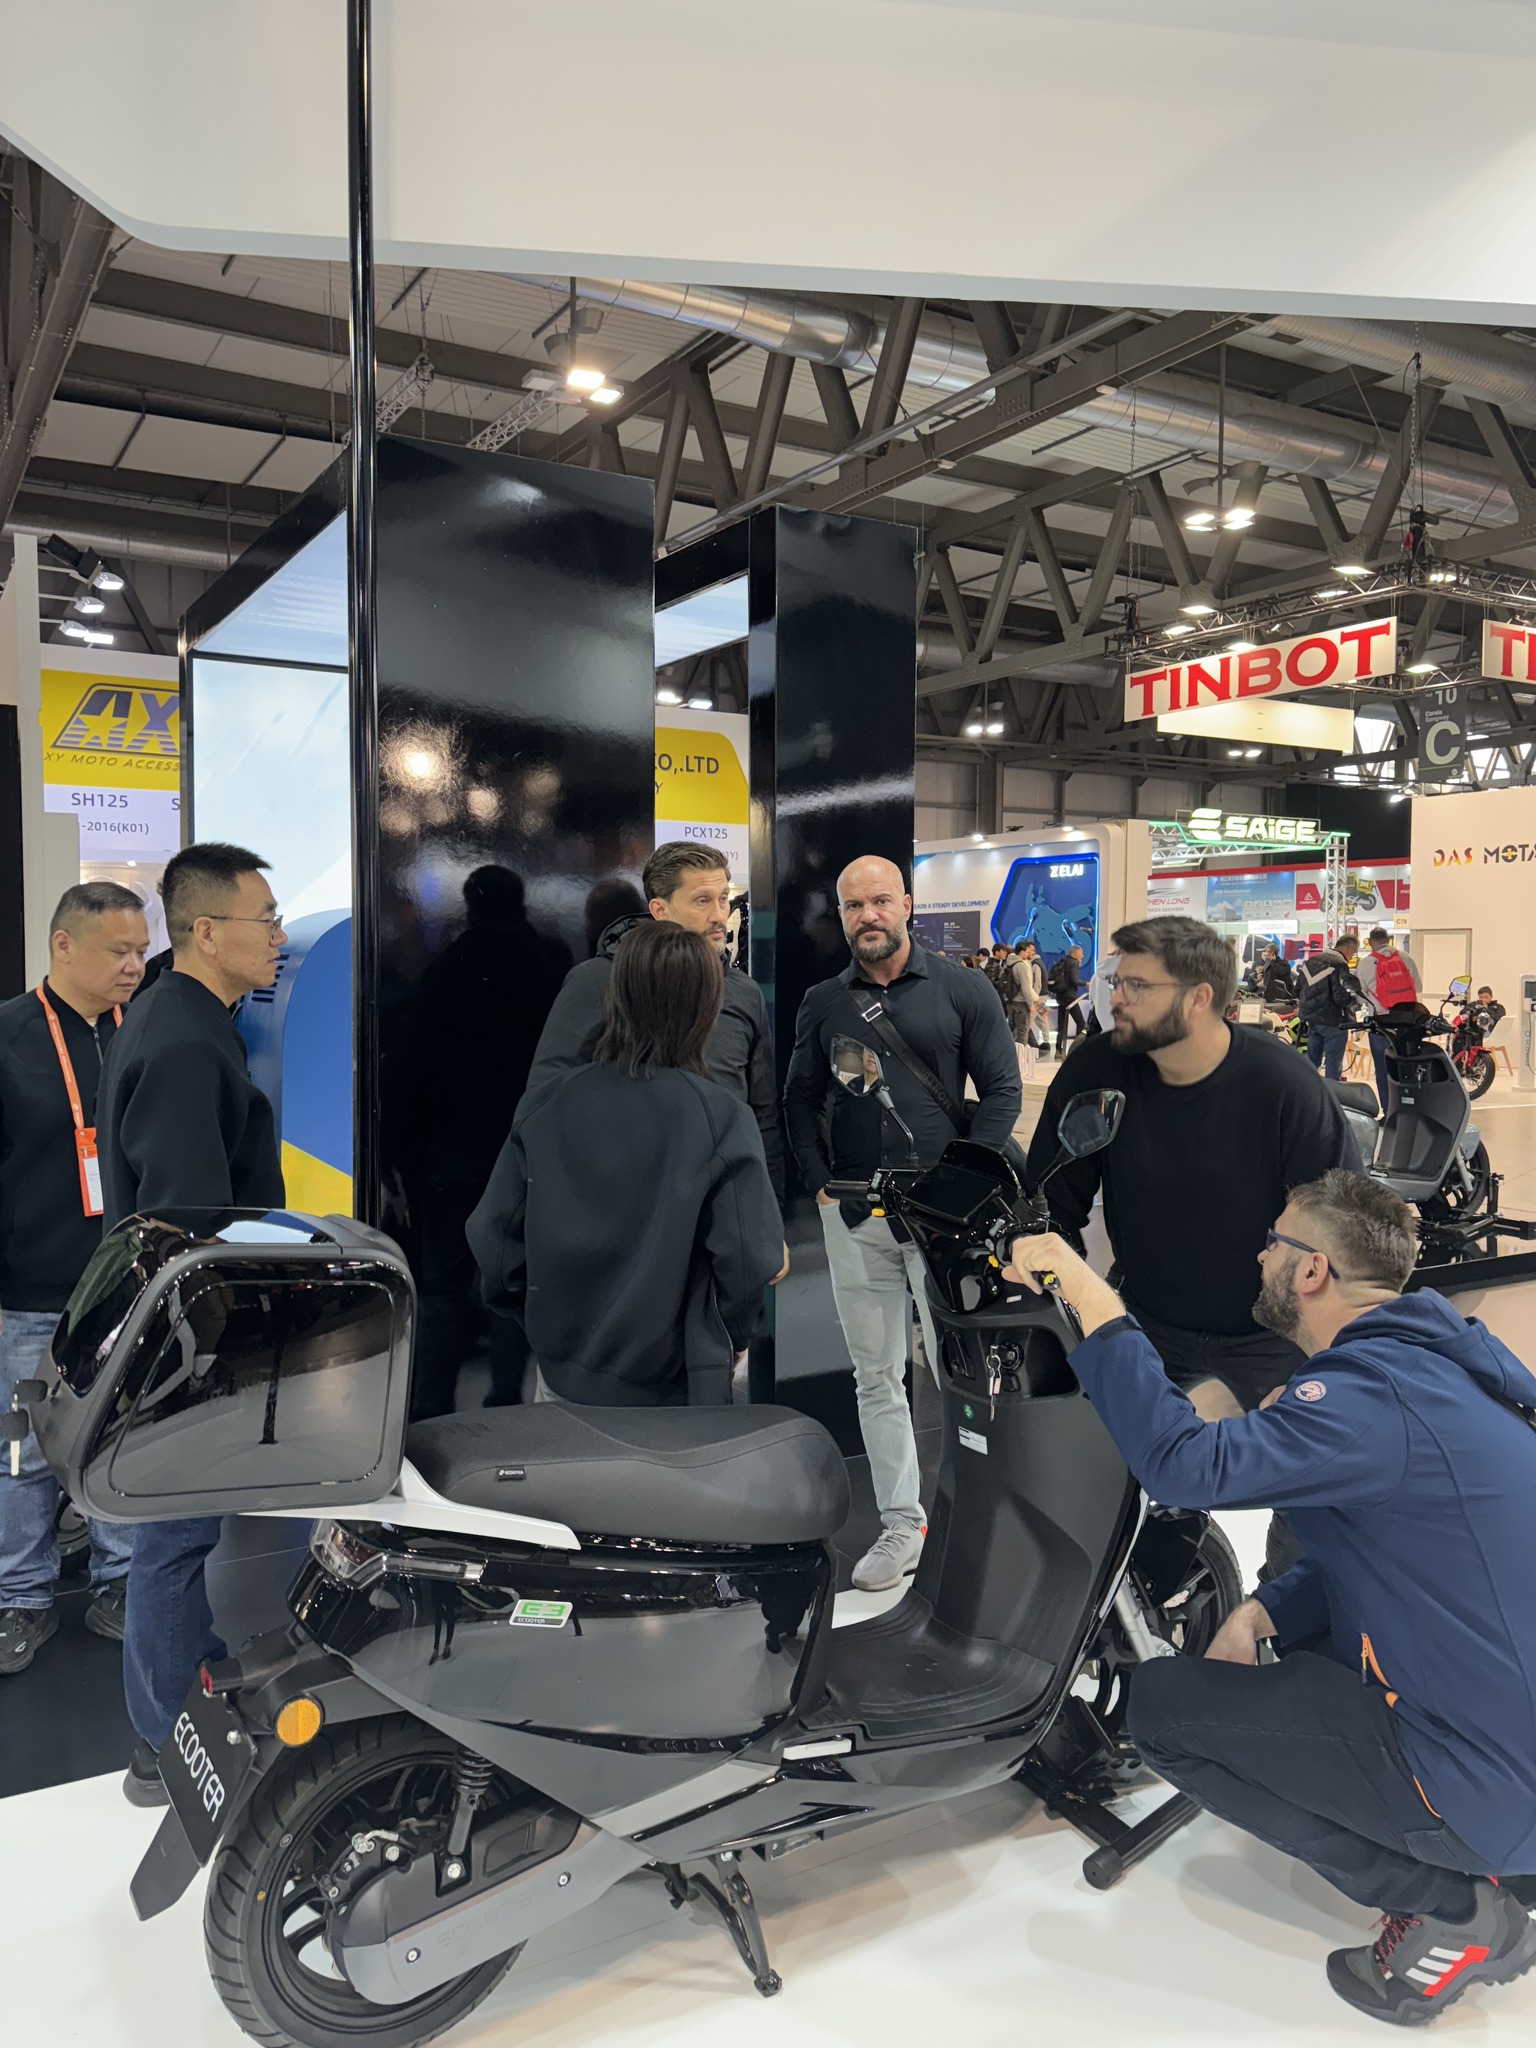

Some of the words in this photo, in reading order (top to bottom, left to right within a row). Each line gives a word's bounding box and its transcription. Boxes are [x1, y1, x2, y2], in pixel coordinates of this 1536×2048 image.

[1130, 621, 1391, 717] TINBOT
[1425, 720, 1461, 765] C
[71, 754, 117, 767] MOTO
[655, 753, 719, 775] O,.LTD
[71, 792, 128, 808] SH125
[79, 821, 149, 835] -2016(K01)
[684, 827, 728, 839] PCX125
[1433, 847, 1473, 867] DAS
[932, 901, 951, 909] STEADY
[952, 900, 990, 908] DEVELOPMENT
[1167, 897, 1191, 905] LONG
[173, 1711, 225, 1823] ECOOTER
